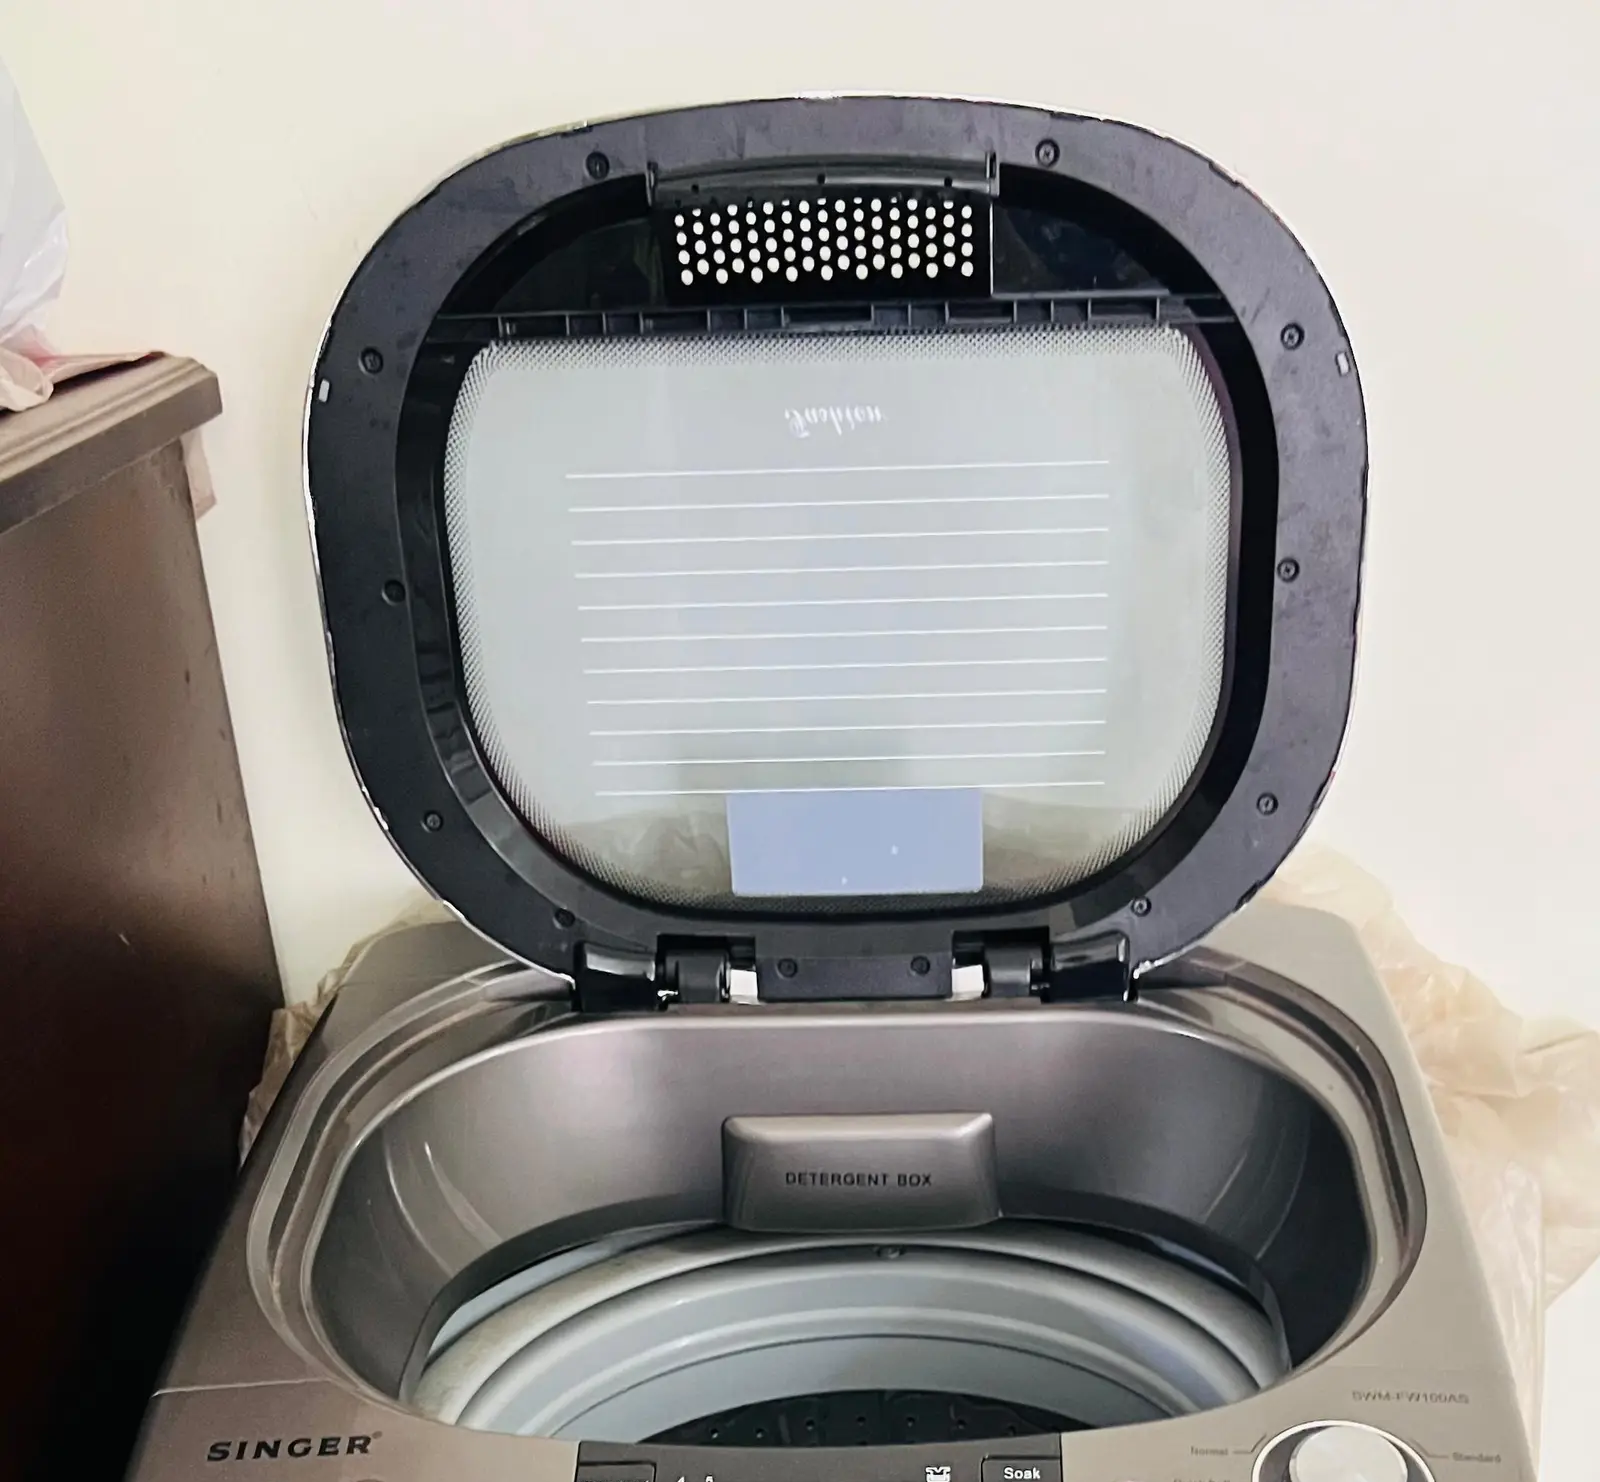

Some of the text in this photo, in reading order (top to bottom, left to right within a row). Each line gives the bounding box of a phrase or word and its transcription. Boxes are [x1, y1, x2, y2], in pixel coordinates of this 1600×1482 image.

[785, 1172, 932, 1187] DETERGENT BOX
[1003, 1467, 1041, 1480] Soak
